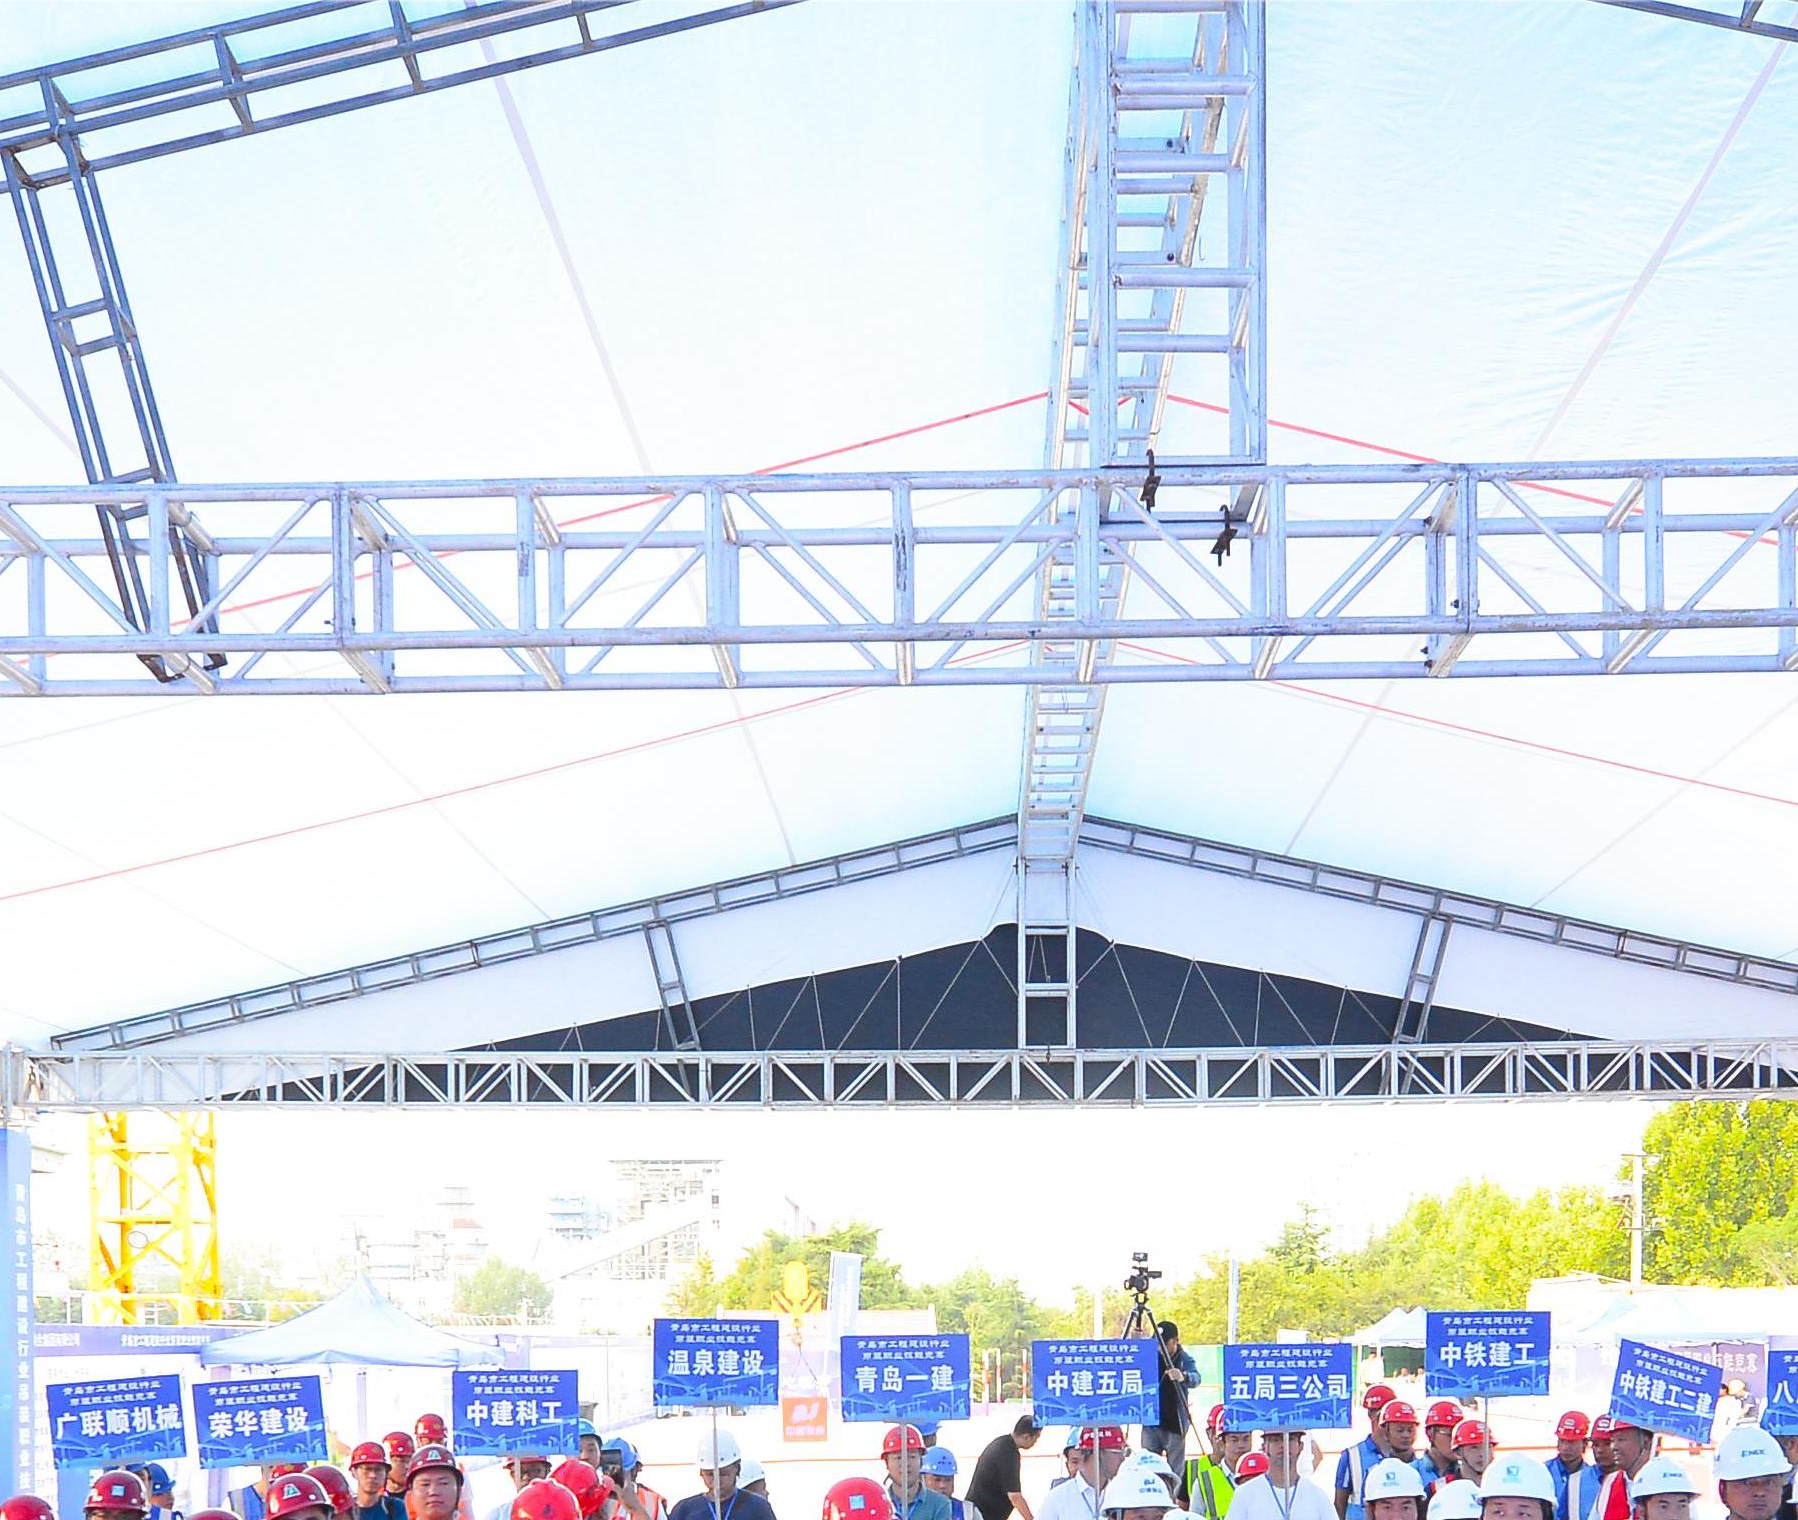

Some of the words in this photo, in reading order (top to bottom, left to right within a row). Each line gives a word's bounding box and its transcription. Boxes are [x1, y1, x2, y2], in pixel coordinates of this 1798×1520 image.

[668, 1350, 764, 1376] 温泉建设
[1441, 1341, 1535, 1367] 中铁建工
[856, 1365, 954, 1392] 青岛一建
[1048, 1370, 1143, 1397] 中建五局
[1230, 1374, 1348, 1401] 五局三公司
[1620, 1371, 1713, 1414] 中铁建工二建
[56, 1403, 181, 1438] 广联顺机械
[209, 1405, 310, 1437] 荣华建设
[466, 1400, 563, 1427] 中建科工
